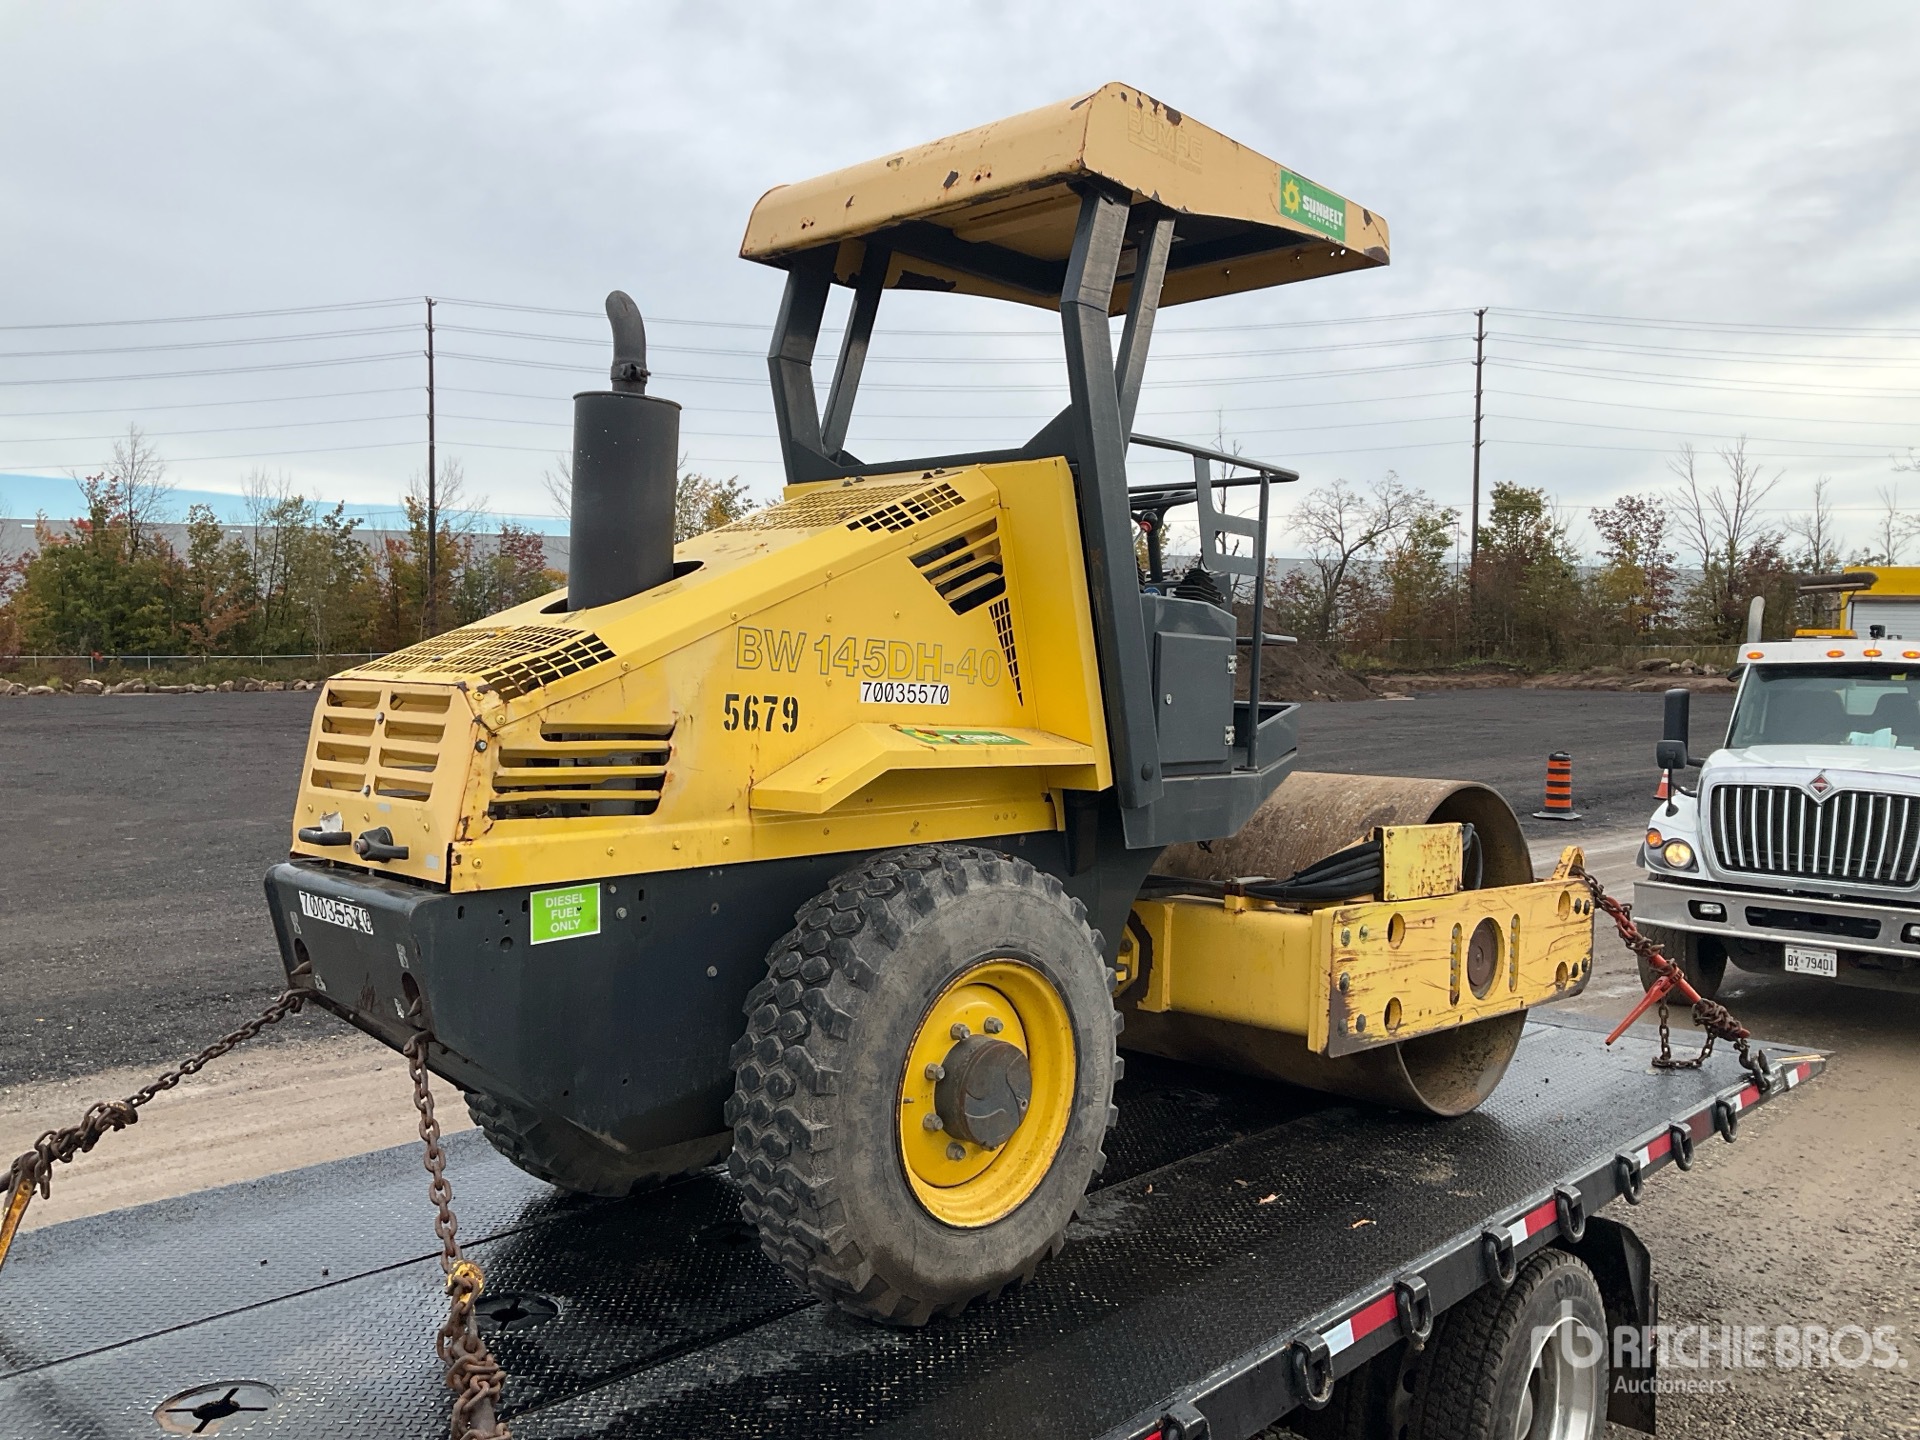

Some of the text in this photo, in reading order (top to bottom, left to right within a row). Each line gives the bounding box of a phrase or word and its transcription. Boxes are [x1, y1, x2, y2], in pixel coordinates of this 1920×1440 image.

[1303, 194, 1344, 228] SUNBELT
[1308, 213, 1339, 232] RENTALS
[736, 626, 1002, 688] BW 145DH-40
[862, 681, 950, 705] 70035570
[723, 693, 799, 733] 5679
[545, 893, 586, 909] DIESEL
[550, 907, 581, 921] FUEL
[550, 918, 581, 934] ONLY
